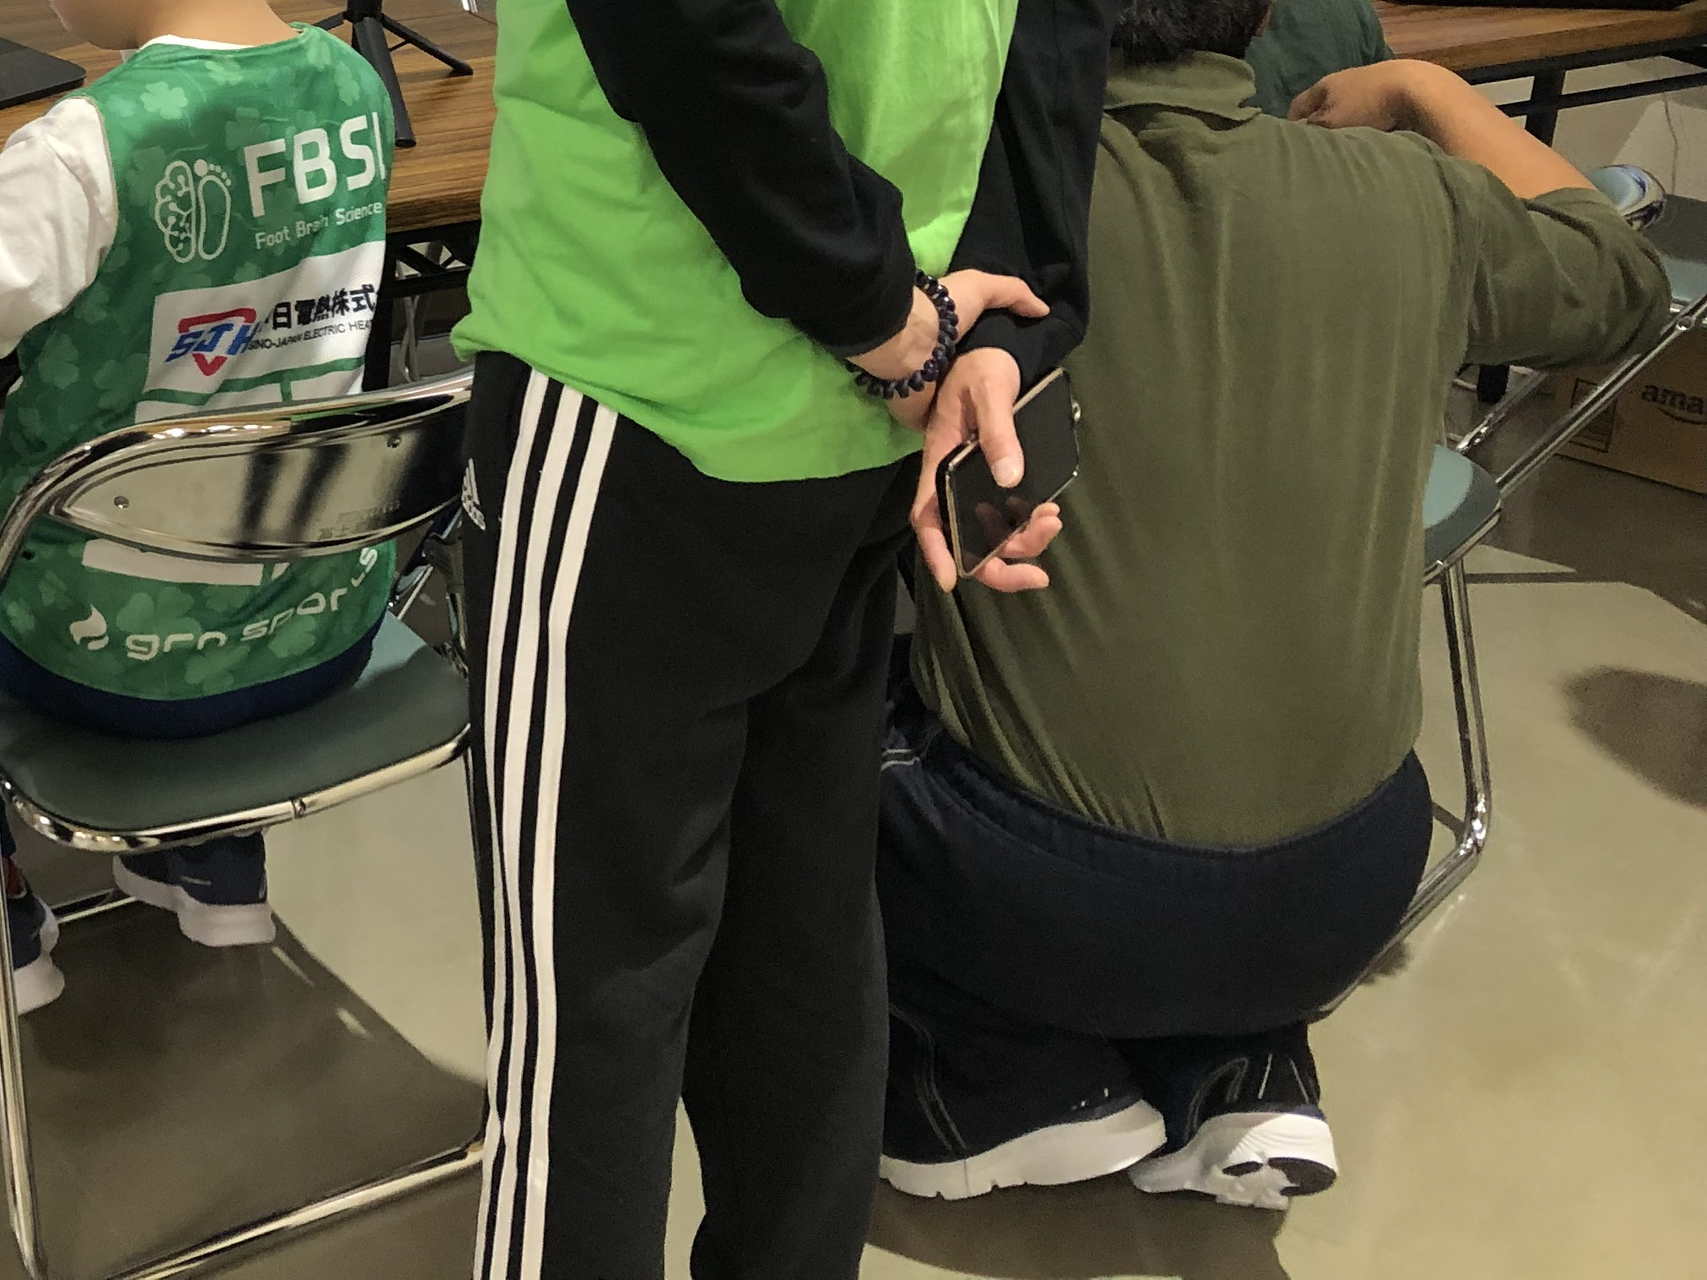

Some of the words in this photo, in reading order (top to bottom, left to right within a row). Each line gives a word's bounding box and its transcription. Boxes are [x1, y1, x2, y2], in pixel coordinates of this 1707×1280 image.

[255, 225, 292, 250] Foot
[335, 201, 383, 226] Science
[165, 322, 262, 363] SJH
[303, 324, 346, 341] ELECTRIC
[125, 631, 227, 661] grn
